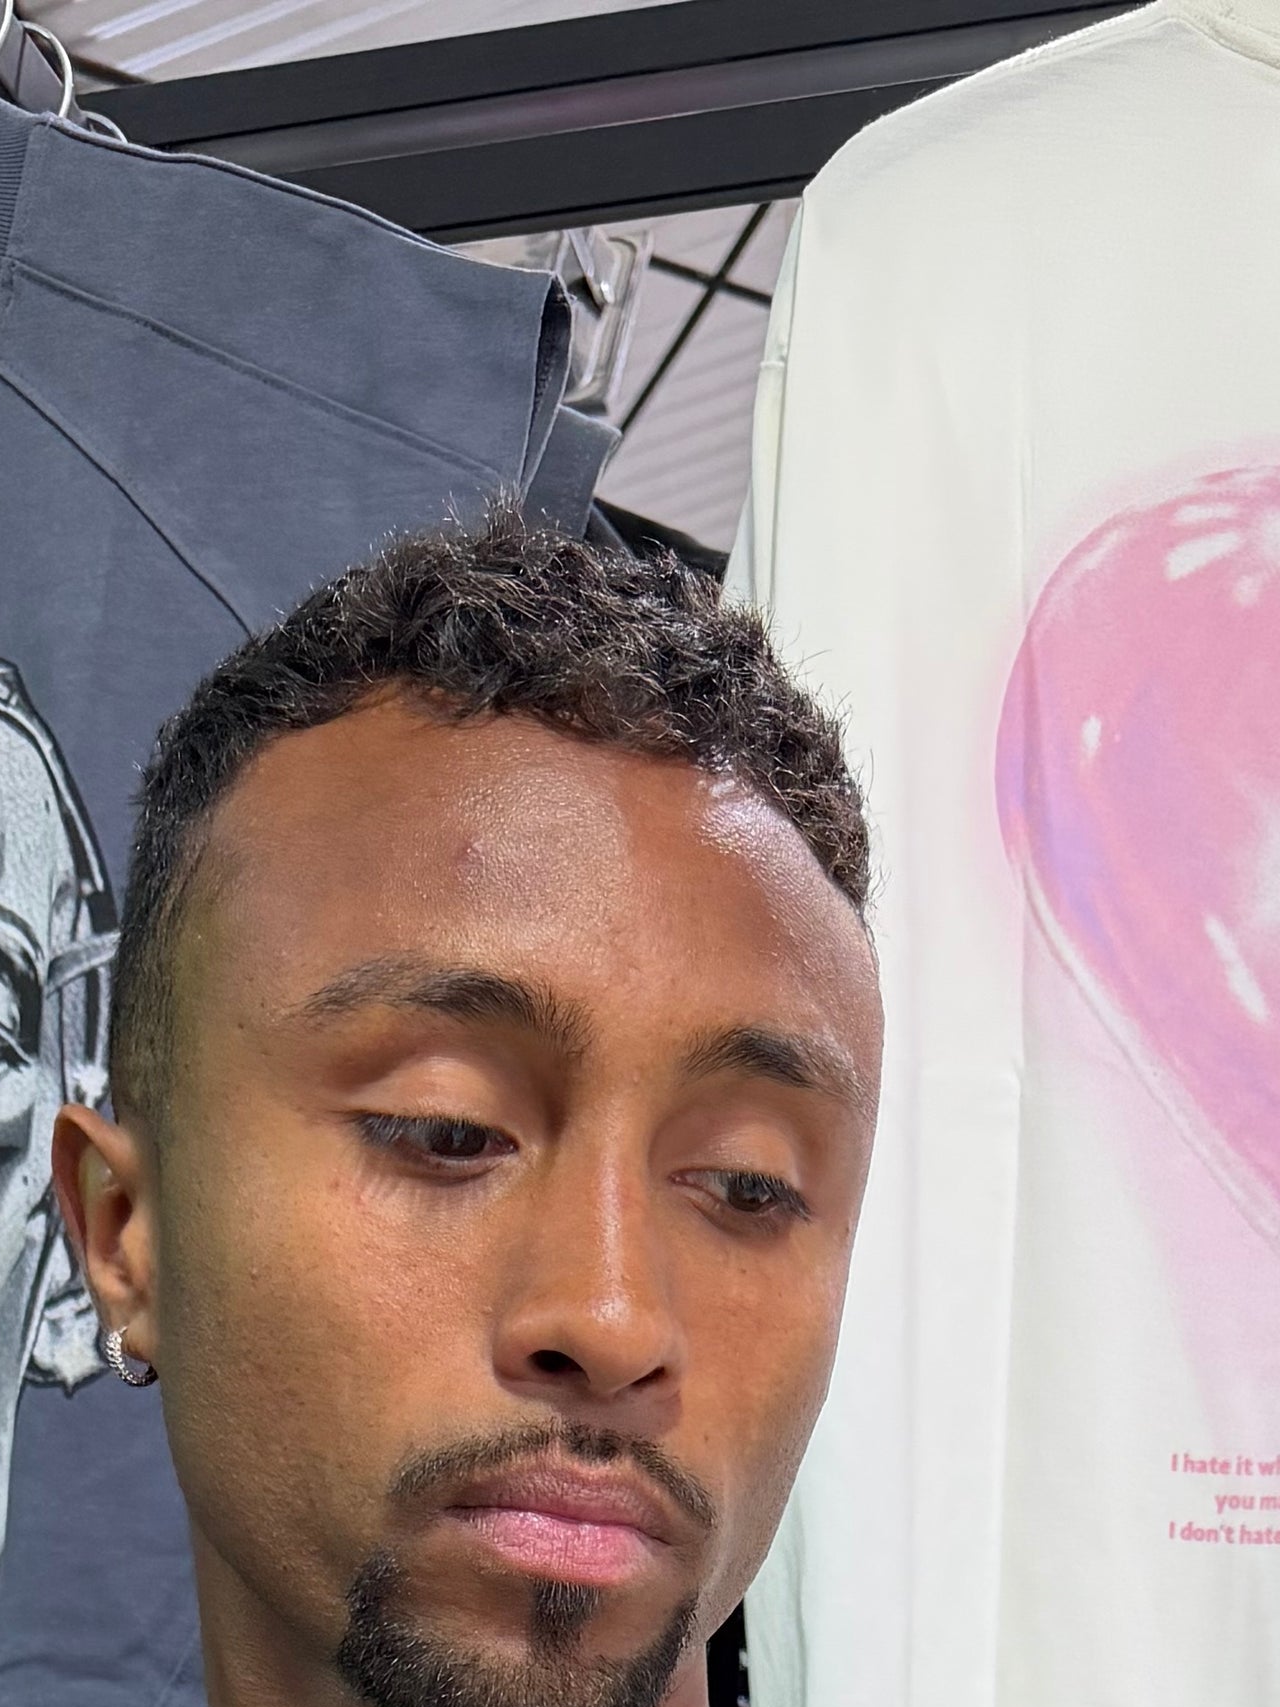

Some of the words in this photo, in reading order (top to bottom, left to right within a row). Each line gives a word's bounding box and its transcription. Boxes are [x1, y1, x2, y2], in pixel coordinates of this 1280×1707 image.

[1170, 1454, 1178, 1472] I
[1183, 1454, 1231, 1475] hate
[1236, 1455, 1254, 1476] it
[1214, 1494, 1255, 1514] you
[1169, 1521, 1176, 1540] I
[1180, 1522, 1235, 1544] don't
